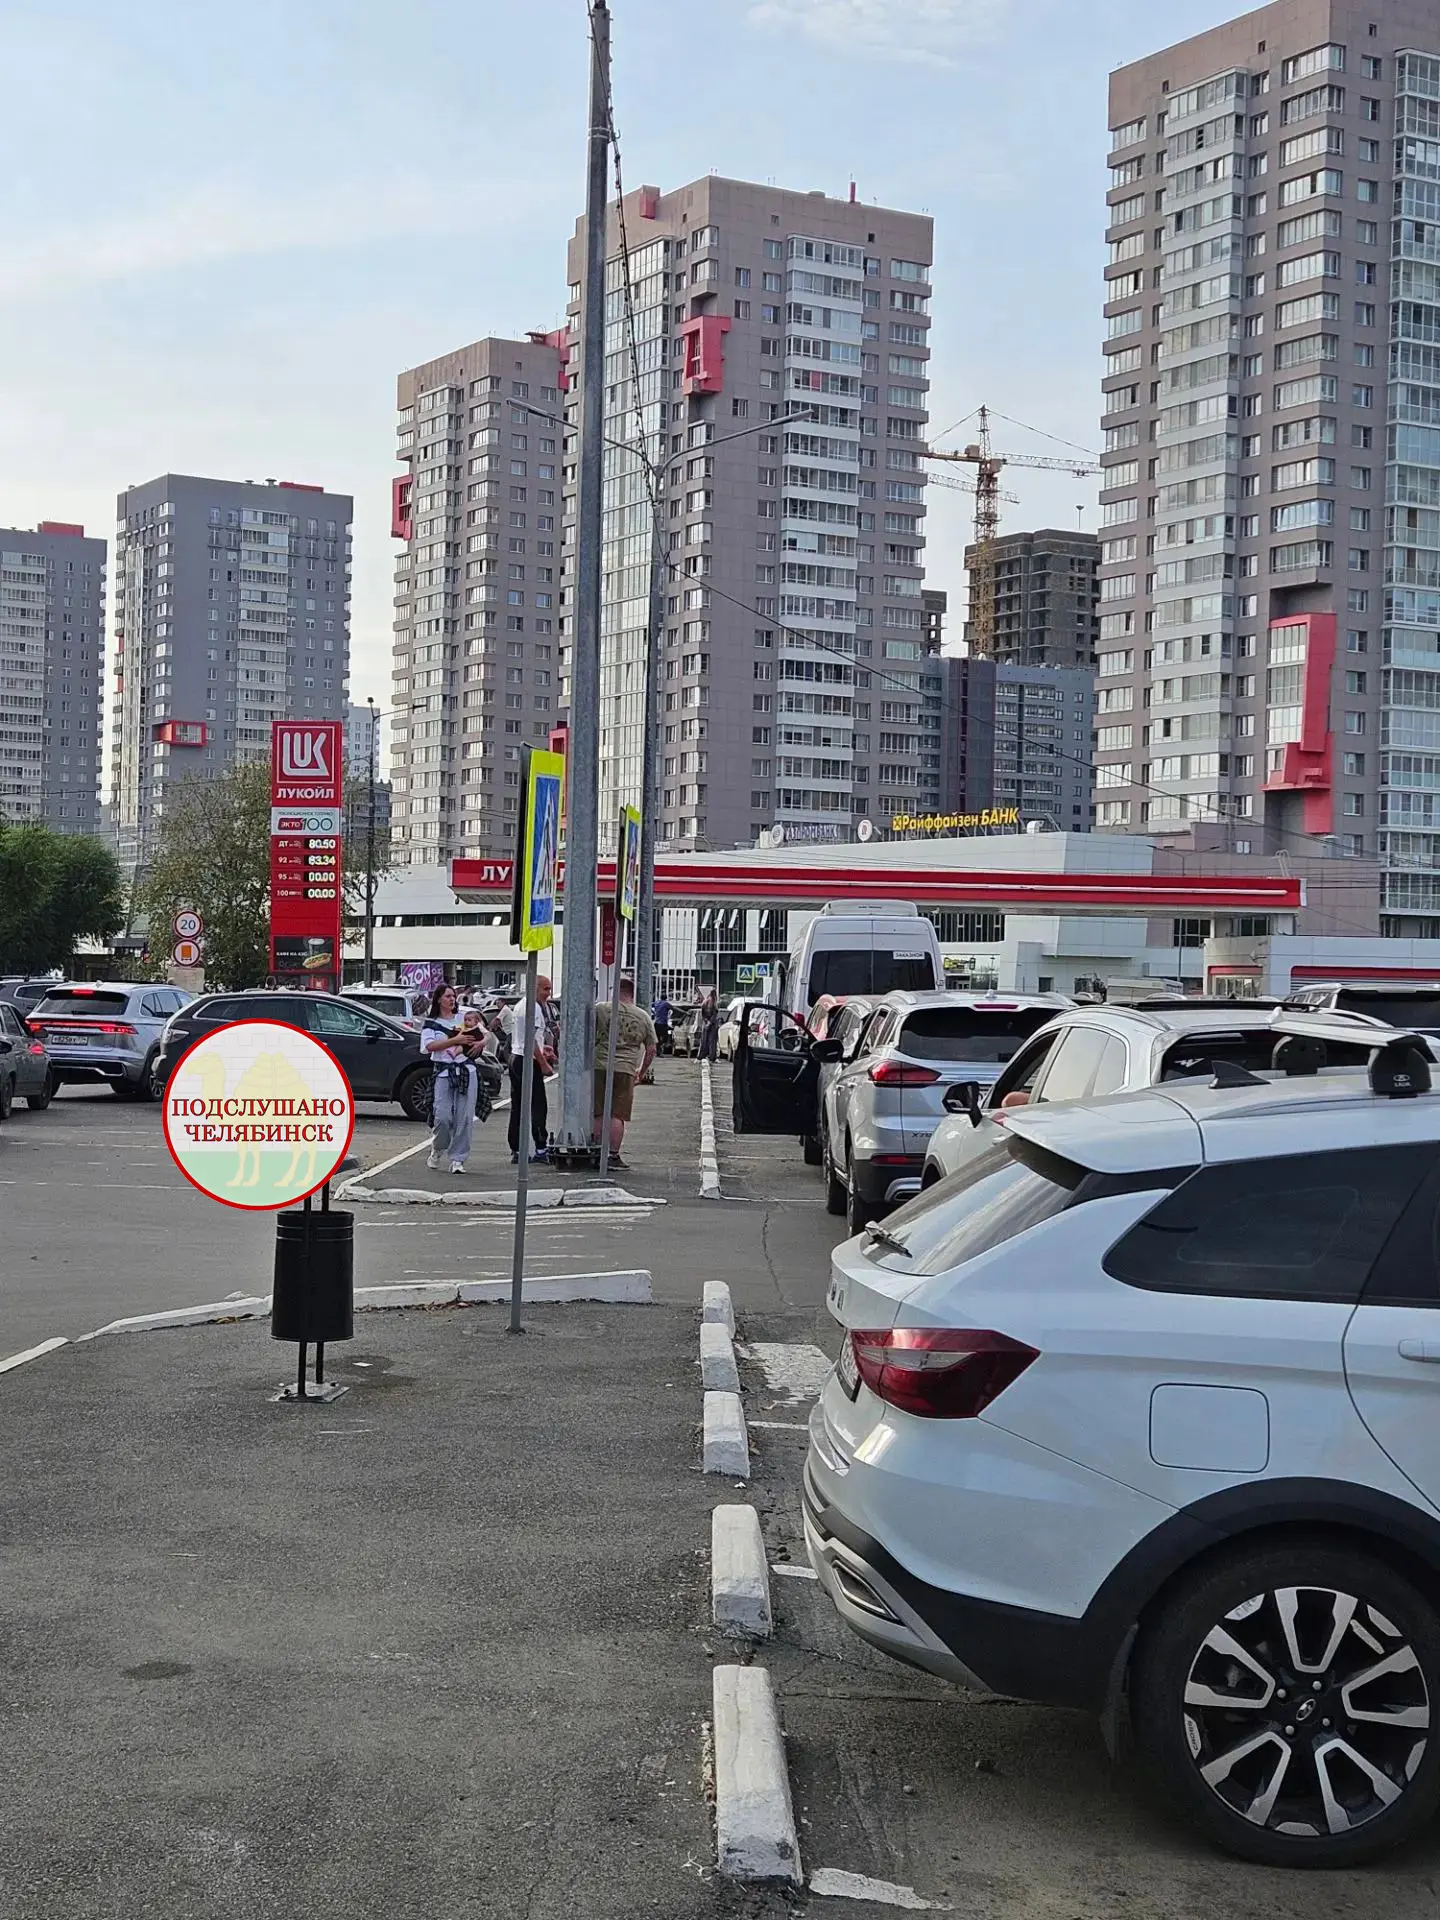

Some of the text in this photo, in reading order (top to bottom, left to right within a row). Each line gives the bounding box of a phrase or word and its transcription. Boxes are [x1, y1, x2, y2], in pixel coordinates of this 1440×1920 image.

[276, 787, 335, 799] ЛУКОЙЛ
[902, 807, 1019, 830] Райффайзен БАНК
[301, 818, 333, 831] 100
[278, 840, 288, 848] ДТ
[278, 856, 287, 864] 92
[277, 889, 288, 897] 100
[180, 919, 196, 930] 20
